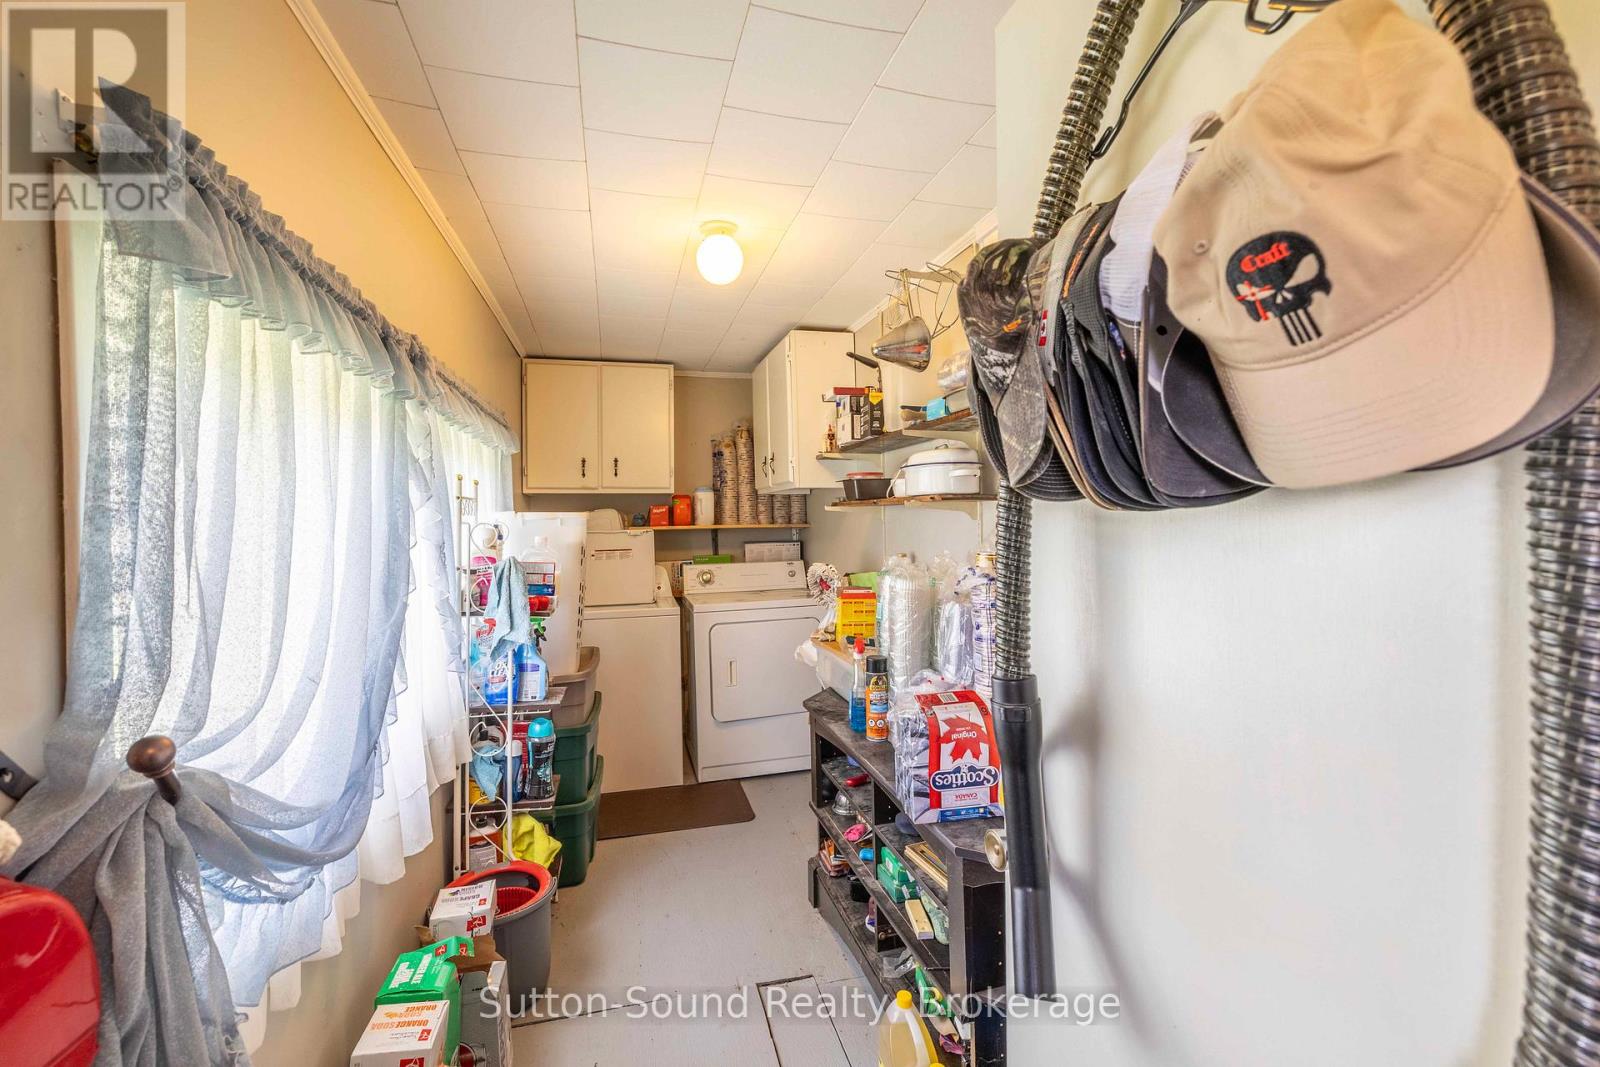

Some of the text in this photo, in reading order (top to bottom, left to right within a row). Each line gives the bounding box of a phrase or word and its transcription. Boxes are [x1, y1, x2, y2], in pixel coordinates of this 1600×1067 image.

[1240, 242, 1290, 273] Craft
[951, 730, 977, 741] Original
[935, 767, 996, 787] Scotties
[405, 1004, 437, 1013] ORANGE
[396, 1019, 429, 1029] ORANGE
